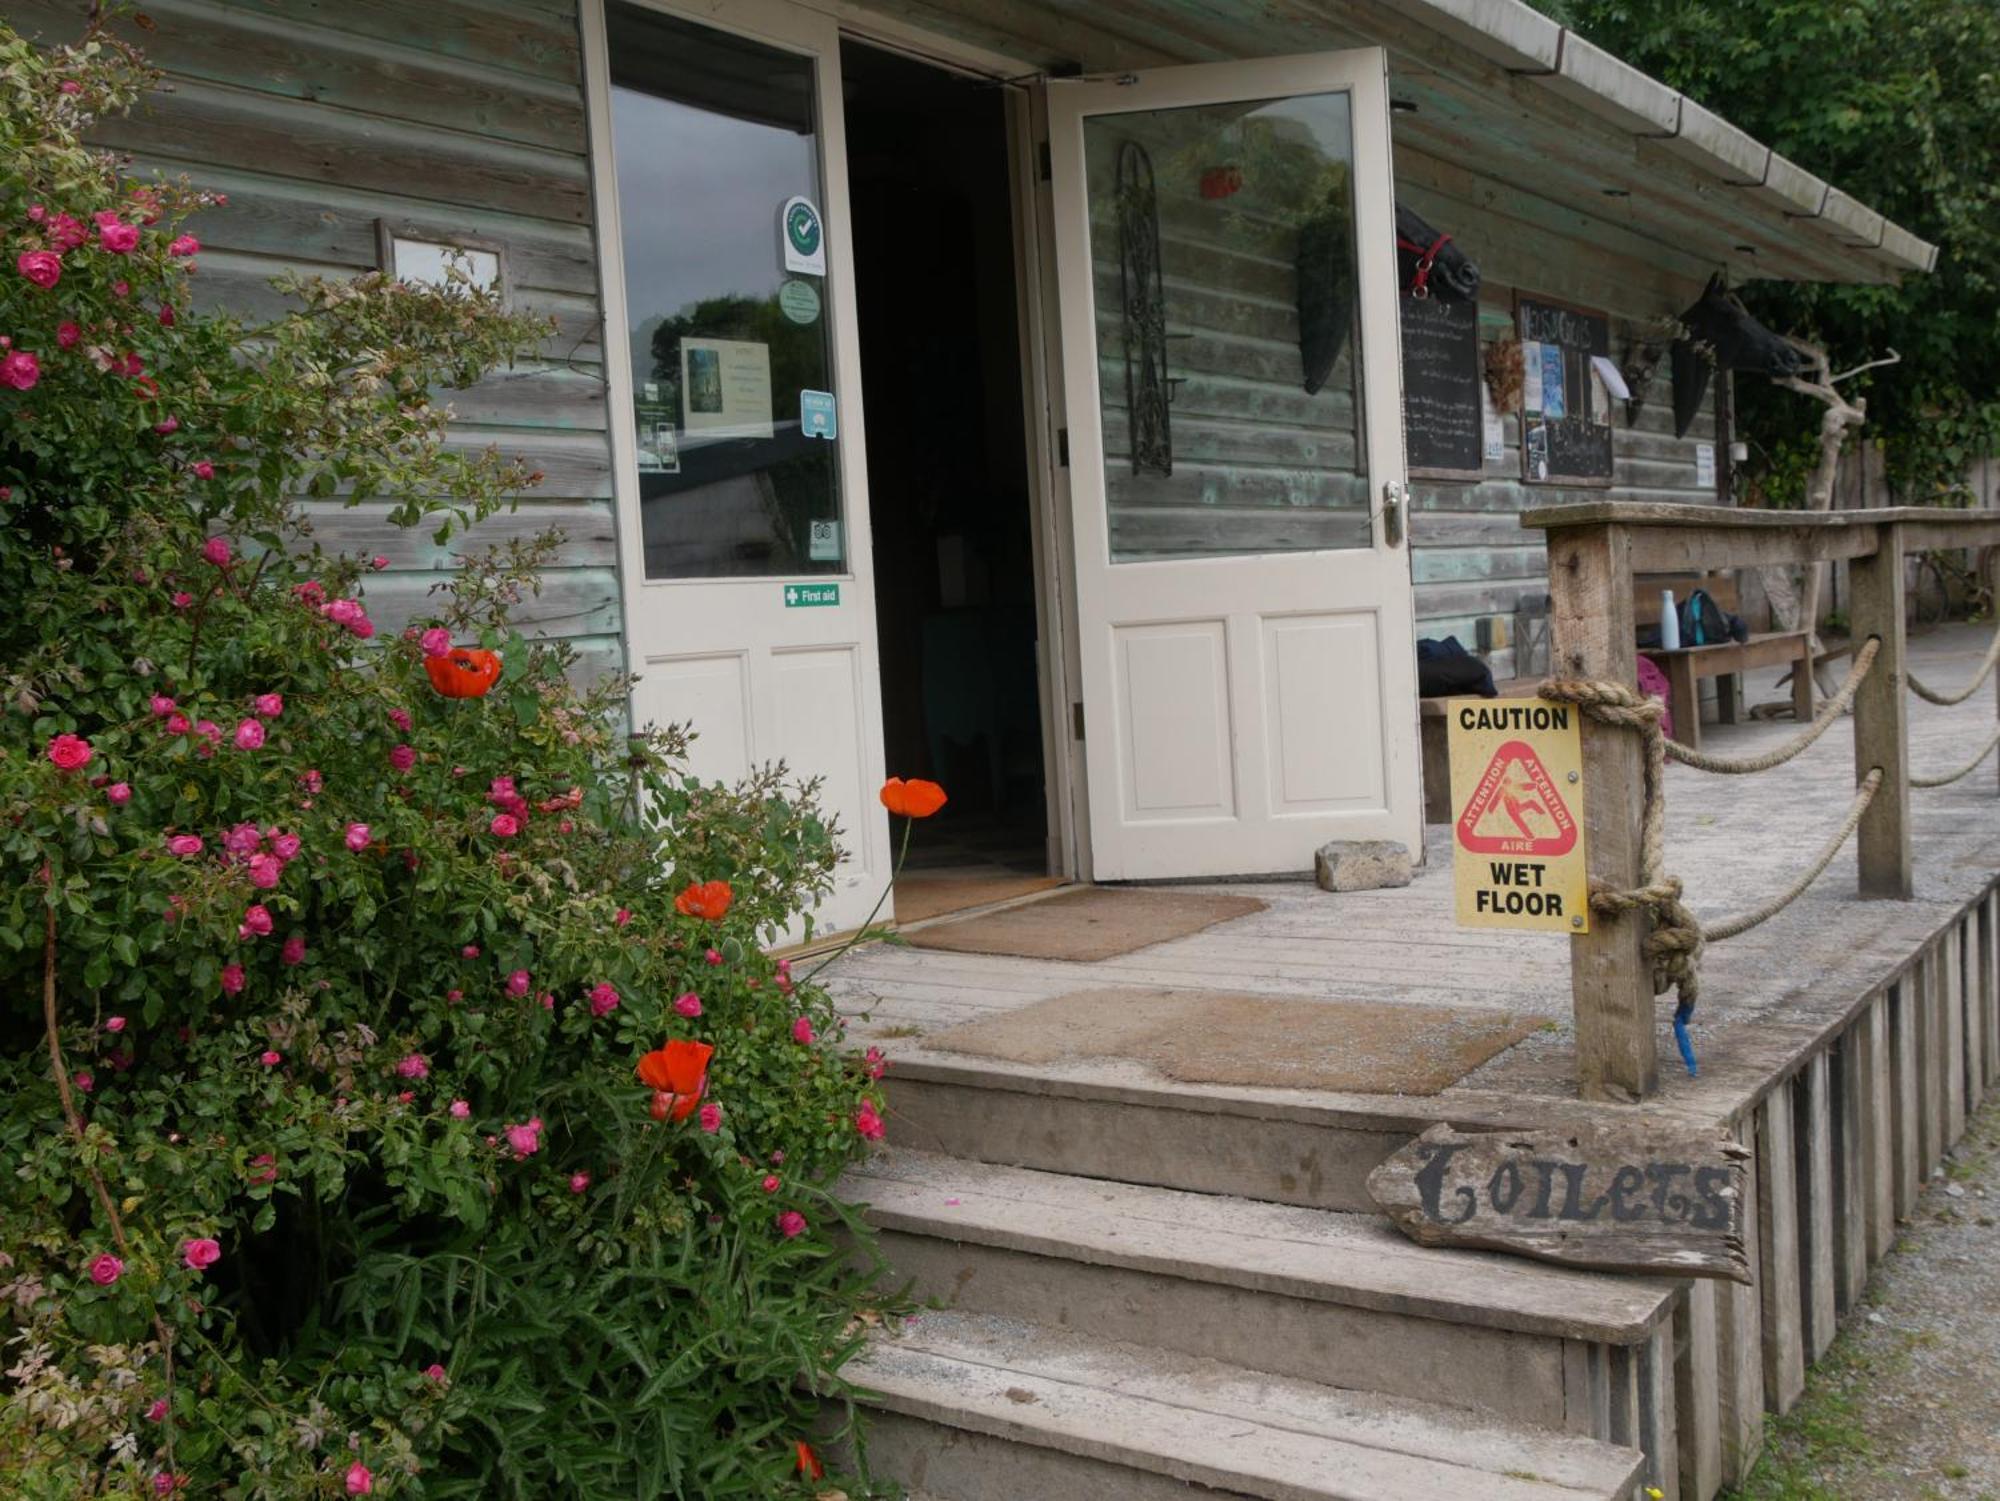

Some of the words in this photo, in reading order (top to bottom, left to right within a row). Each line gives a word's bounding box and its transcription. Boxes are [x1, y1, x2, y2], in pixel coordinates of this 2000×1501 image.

[802, 590, 820, 602] First
[823, 589, 836, 601] aid
[1459, 707, 1568, 730] CAUTION
[1463, 757, 1505, 828] ATTENTION
[1525, 758, 1572, 830] ATTENTION
[1501, 840, 1533, 852] AIRE
[1490, 862, 1546, 887] WET
[1476, 890, 1563, 917] FLOOR
